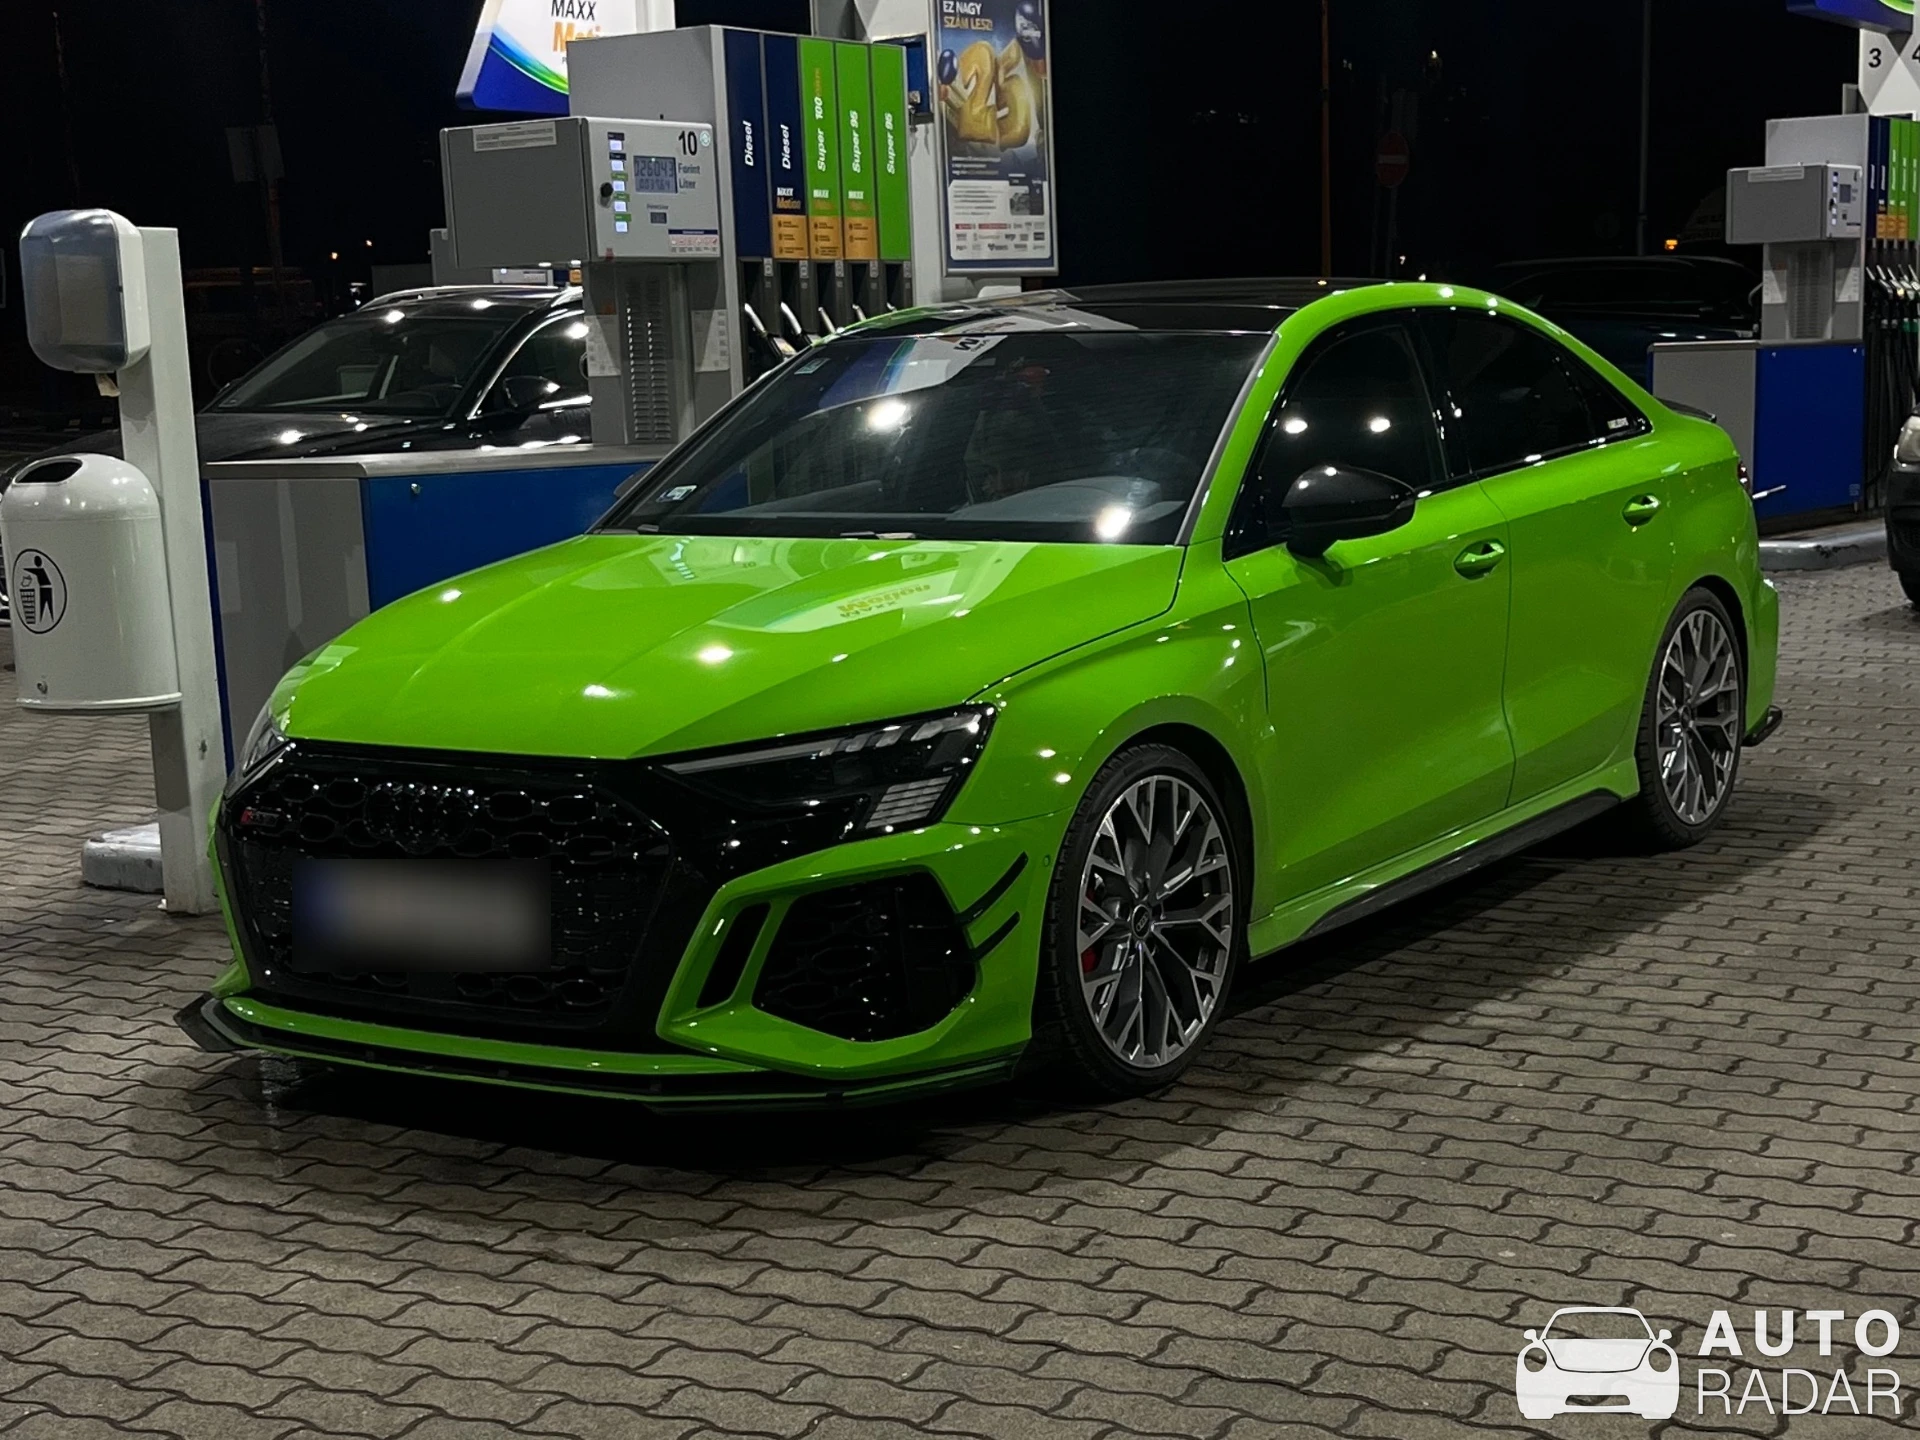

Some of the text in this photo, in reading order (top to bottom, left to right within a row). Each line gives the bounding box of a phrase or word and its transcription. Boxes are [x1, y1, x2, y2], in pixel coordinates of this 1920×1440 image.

[551, 0, 597, 21] MAXX
[943, 1, 982, 16] EZ NAGY
[1868, 48, 1882, 68] 3
[814, 96, 824, 120] 100
[679, 130, 698, 155] 10
[743, 120, 755, 167] Diesel
[780, 124, 792, 170] Diesel
[817, 128, 827, 172] Super
[851, 129, 861, 174] Super
[886, 132, 896, 175] Super
